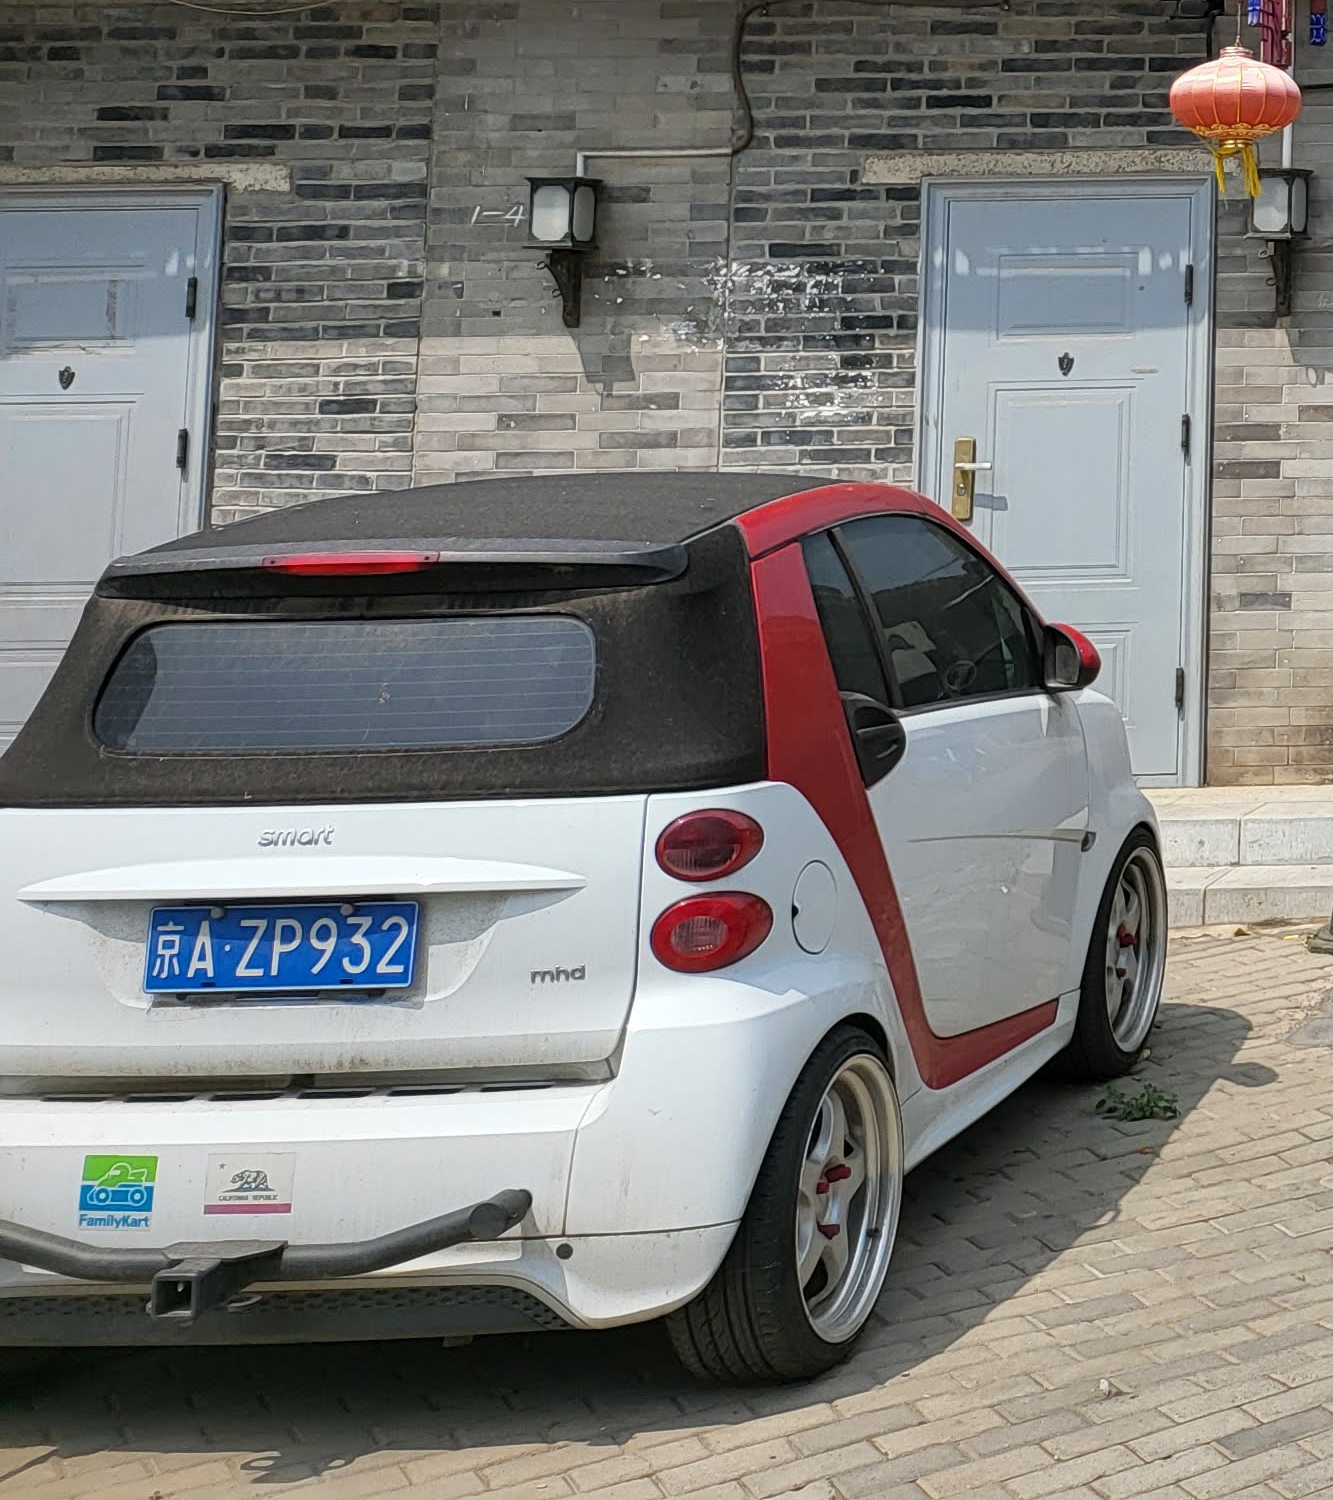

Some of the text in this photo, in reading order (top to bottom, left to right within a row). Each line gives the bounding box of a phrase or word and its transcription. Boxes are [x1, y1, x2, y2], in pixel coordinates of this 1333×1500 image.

[470, 204, 526, 228] 1-4
[258, 823, 336, 848] smart
[529, 962, 586, 984] mhd
[218, 1194, 249, 1202] CALIFORNIA
[79, 1213, 150, 1229] FamilyKart
